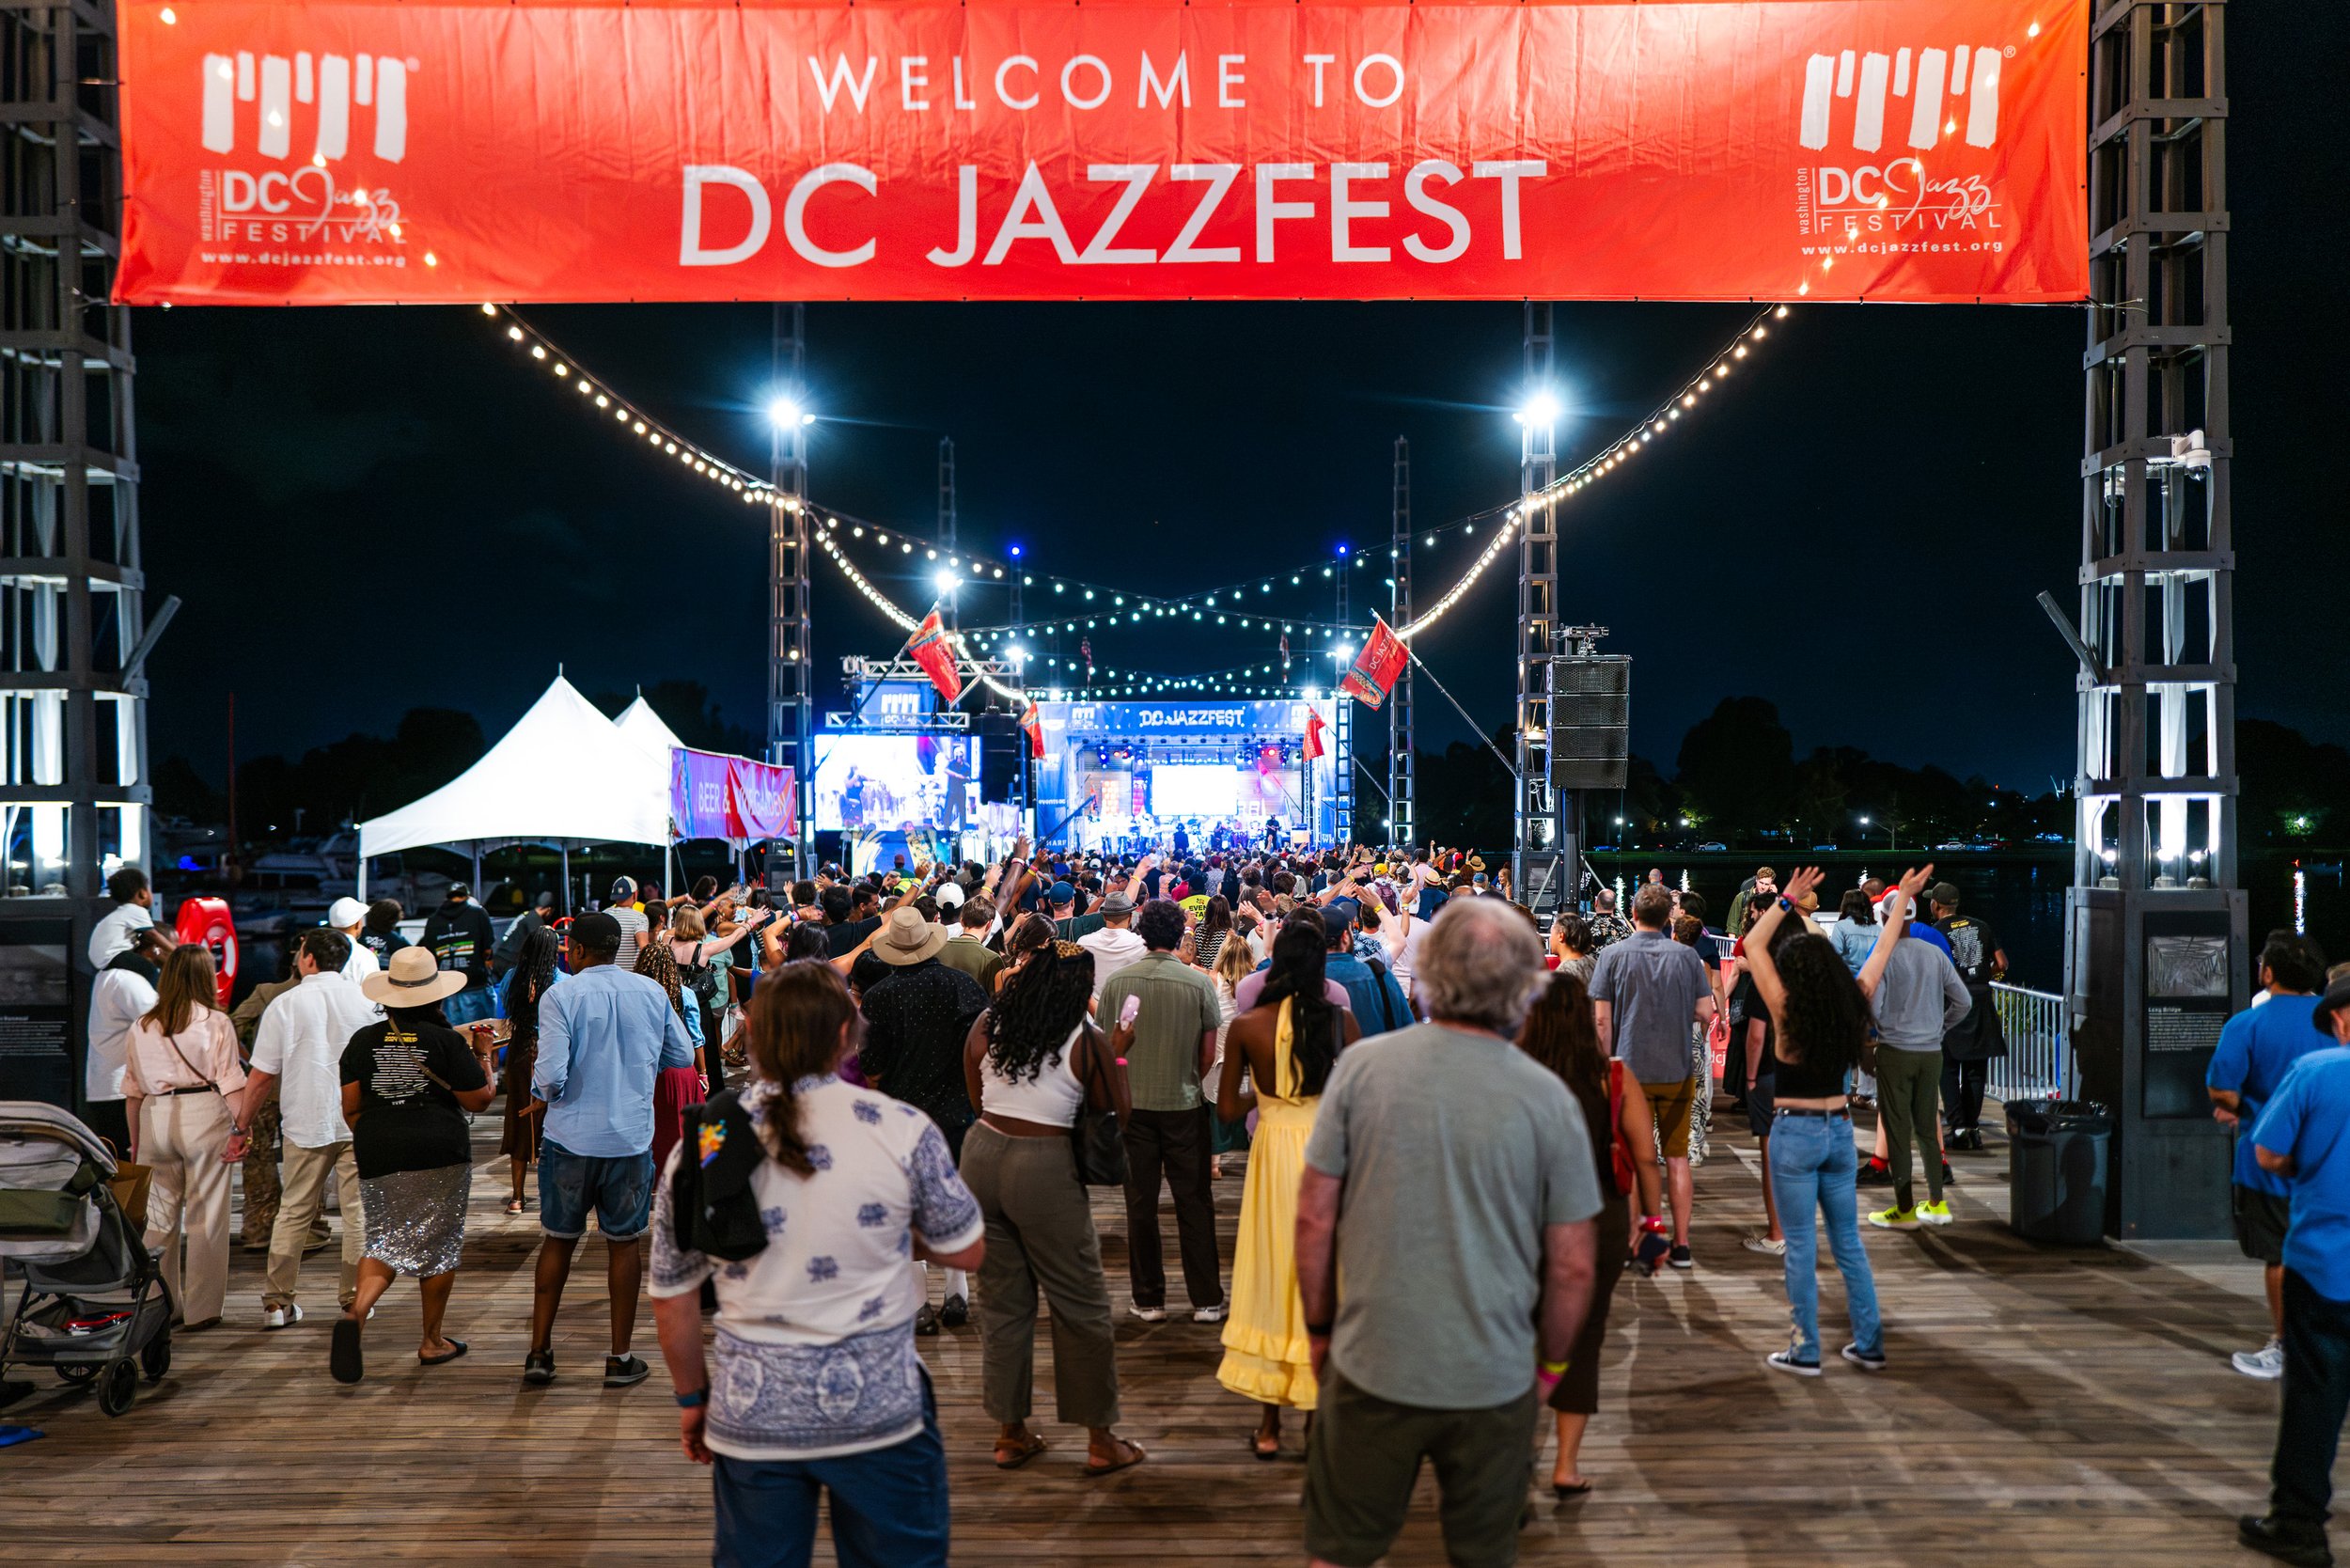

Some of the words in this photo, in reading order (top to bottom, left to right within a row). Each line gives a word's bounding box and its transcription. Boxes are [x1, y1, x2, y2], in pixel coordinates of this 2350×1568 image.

[807, 51, 1246, 115] WELCOME
[1304, 53, 1405, 108] TO
[223, 170, 290, 213] DC
[1795, 167, 1810, 235] washington
[1819, 165, 1883, 206] DC
[1883, 157, 1992, 228] Jazz
[680, 162, 877, 268] DC
[925, 158, 1547, 268] JAZZFEST
[1820, 212, 2001, 233] FESTIVAL
[223, 222, 407, 243] FESTIVAL
[1802, 241, 2003, 256] www.dcjazzfest.org
[1141, 710, 1165, 727] DC
[1167, 709, 1245, 727] JAZZFEST
[698, 781, 721, 814] BEER
